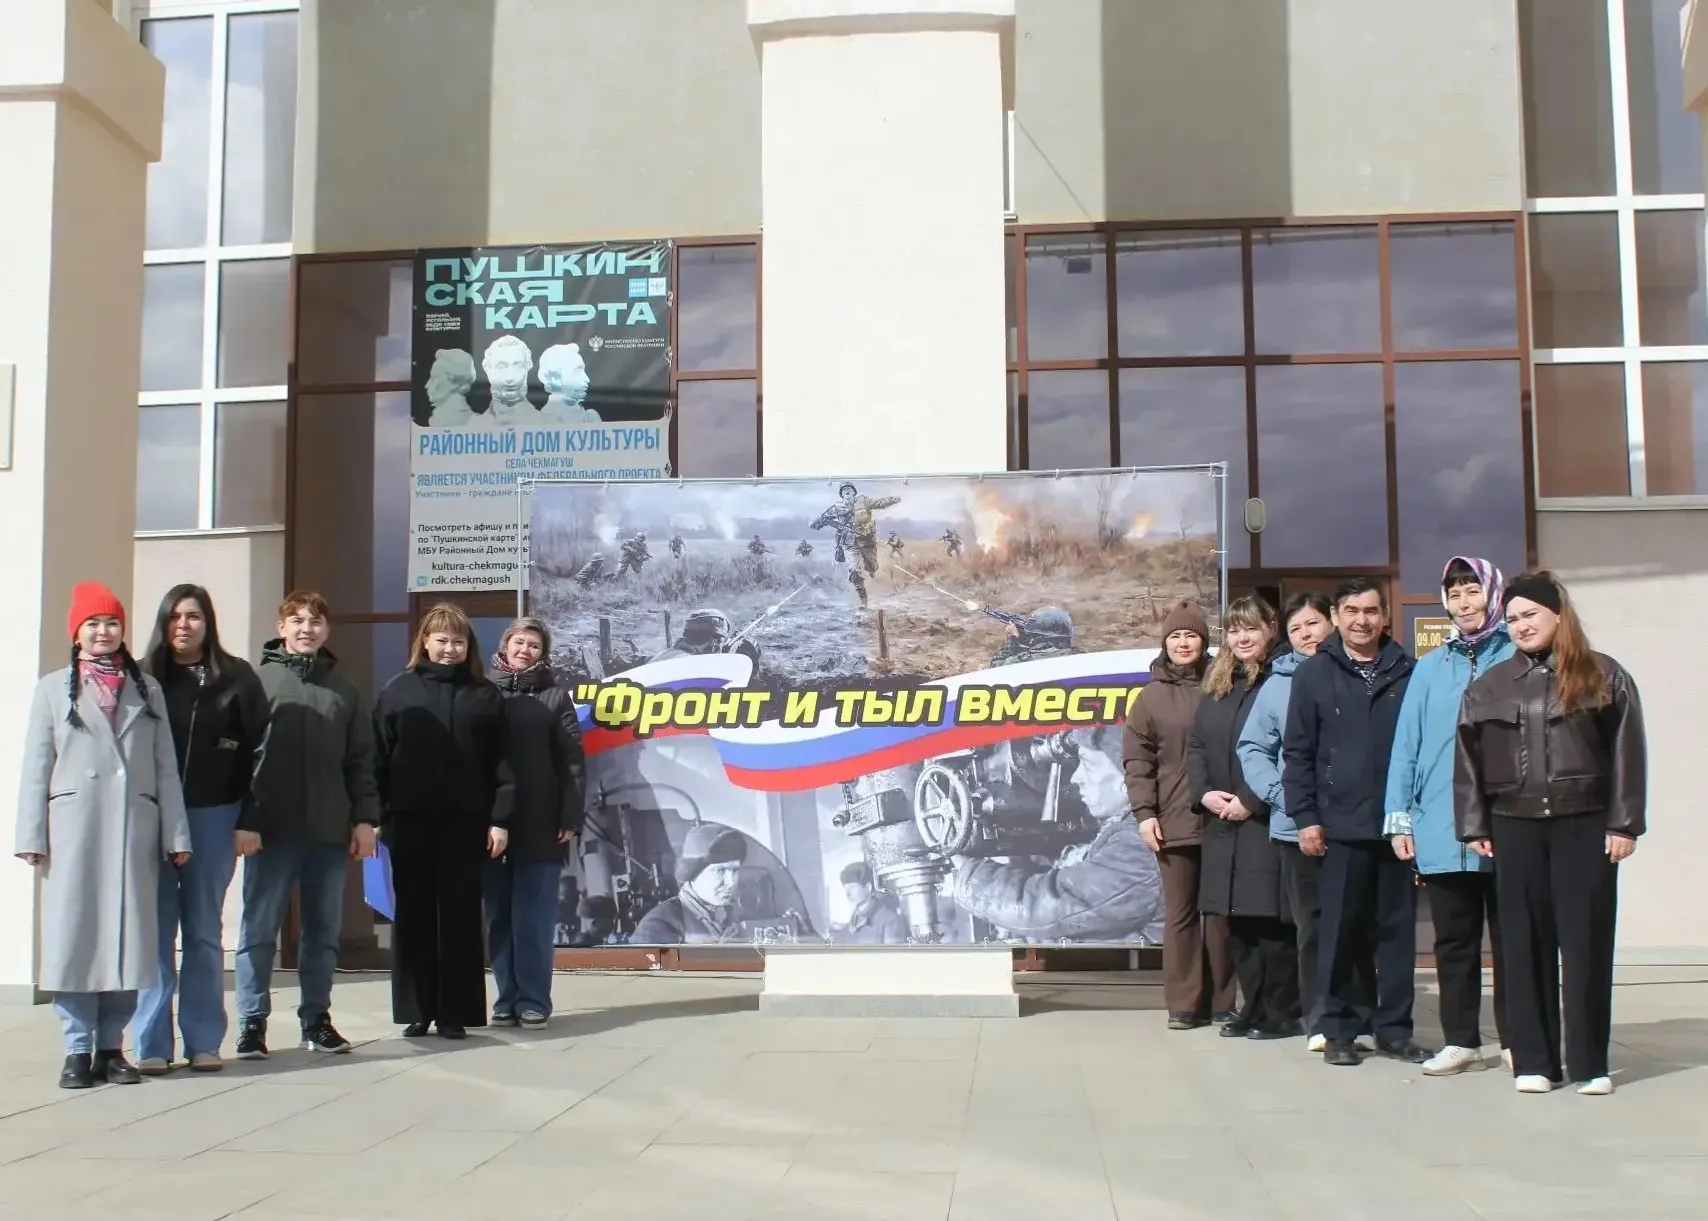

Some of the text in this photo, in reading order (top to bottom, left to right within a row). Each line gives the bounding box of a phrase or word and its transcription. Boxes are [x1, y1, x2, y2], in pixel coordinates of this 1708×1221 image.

[425, 251, 660, 282] ПУШКИН
[425, 279, 564, 306] СКАЯ
[485, 302, 657, 330] КАРТА
[419, 428, 661, 456] РАЙОННЫЙ ДОМ КУЛЬТУРЫ
[505, 457, 574, 469] СЕЛА ЧЕКМАГУШ
[417, 473, 467, 487] ЯВЛЯЕТСЯ
[618, 468, 662, 479] ПРОЕКТА
[415, 490, 461, 499] Участники
[418, 524, 472, 533] Посмотреть
[473, 522, 503, 532] афишу
[417, 547, 437, 555] МБУ
[439, 546, 484, 555] Районный
[486, 545, 506, 555] Дом
[431, 574, 511, 586] rdk.chekmagush
[576, 682, 771, 735] "Фронт
[783, 691, 820, 724] и
[834, 690, 944, 724] тыл
